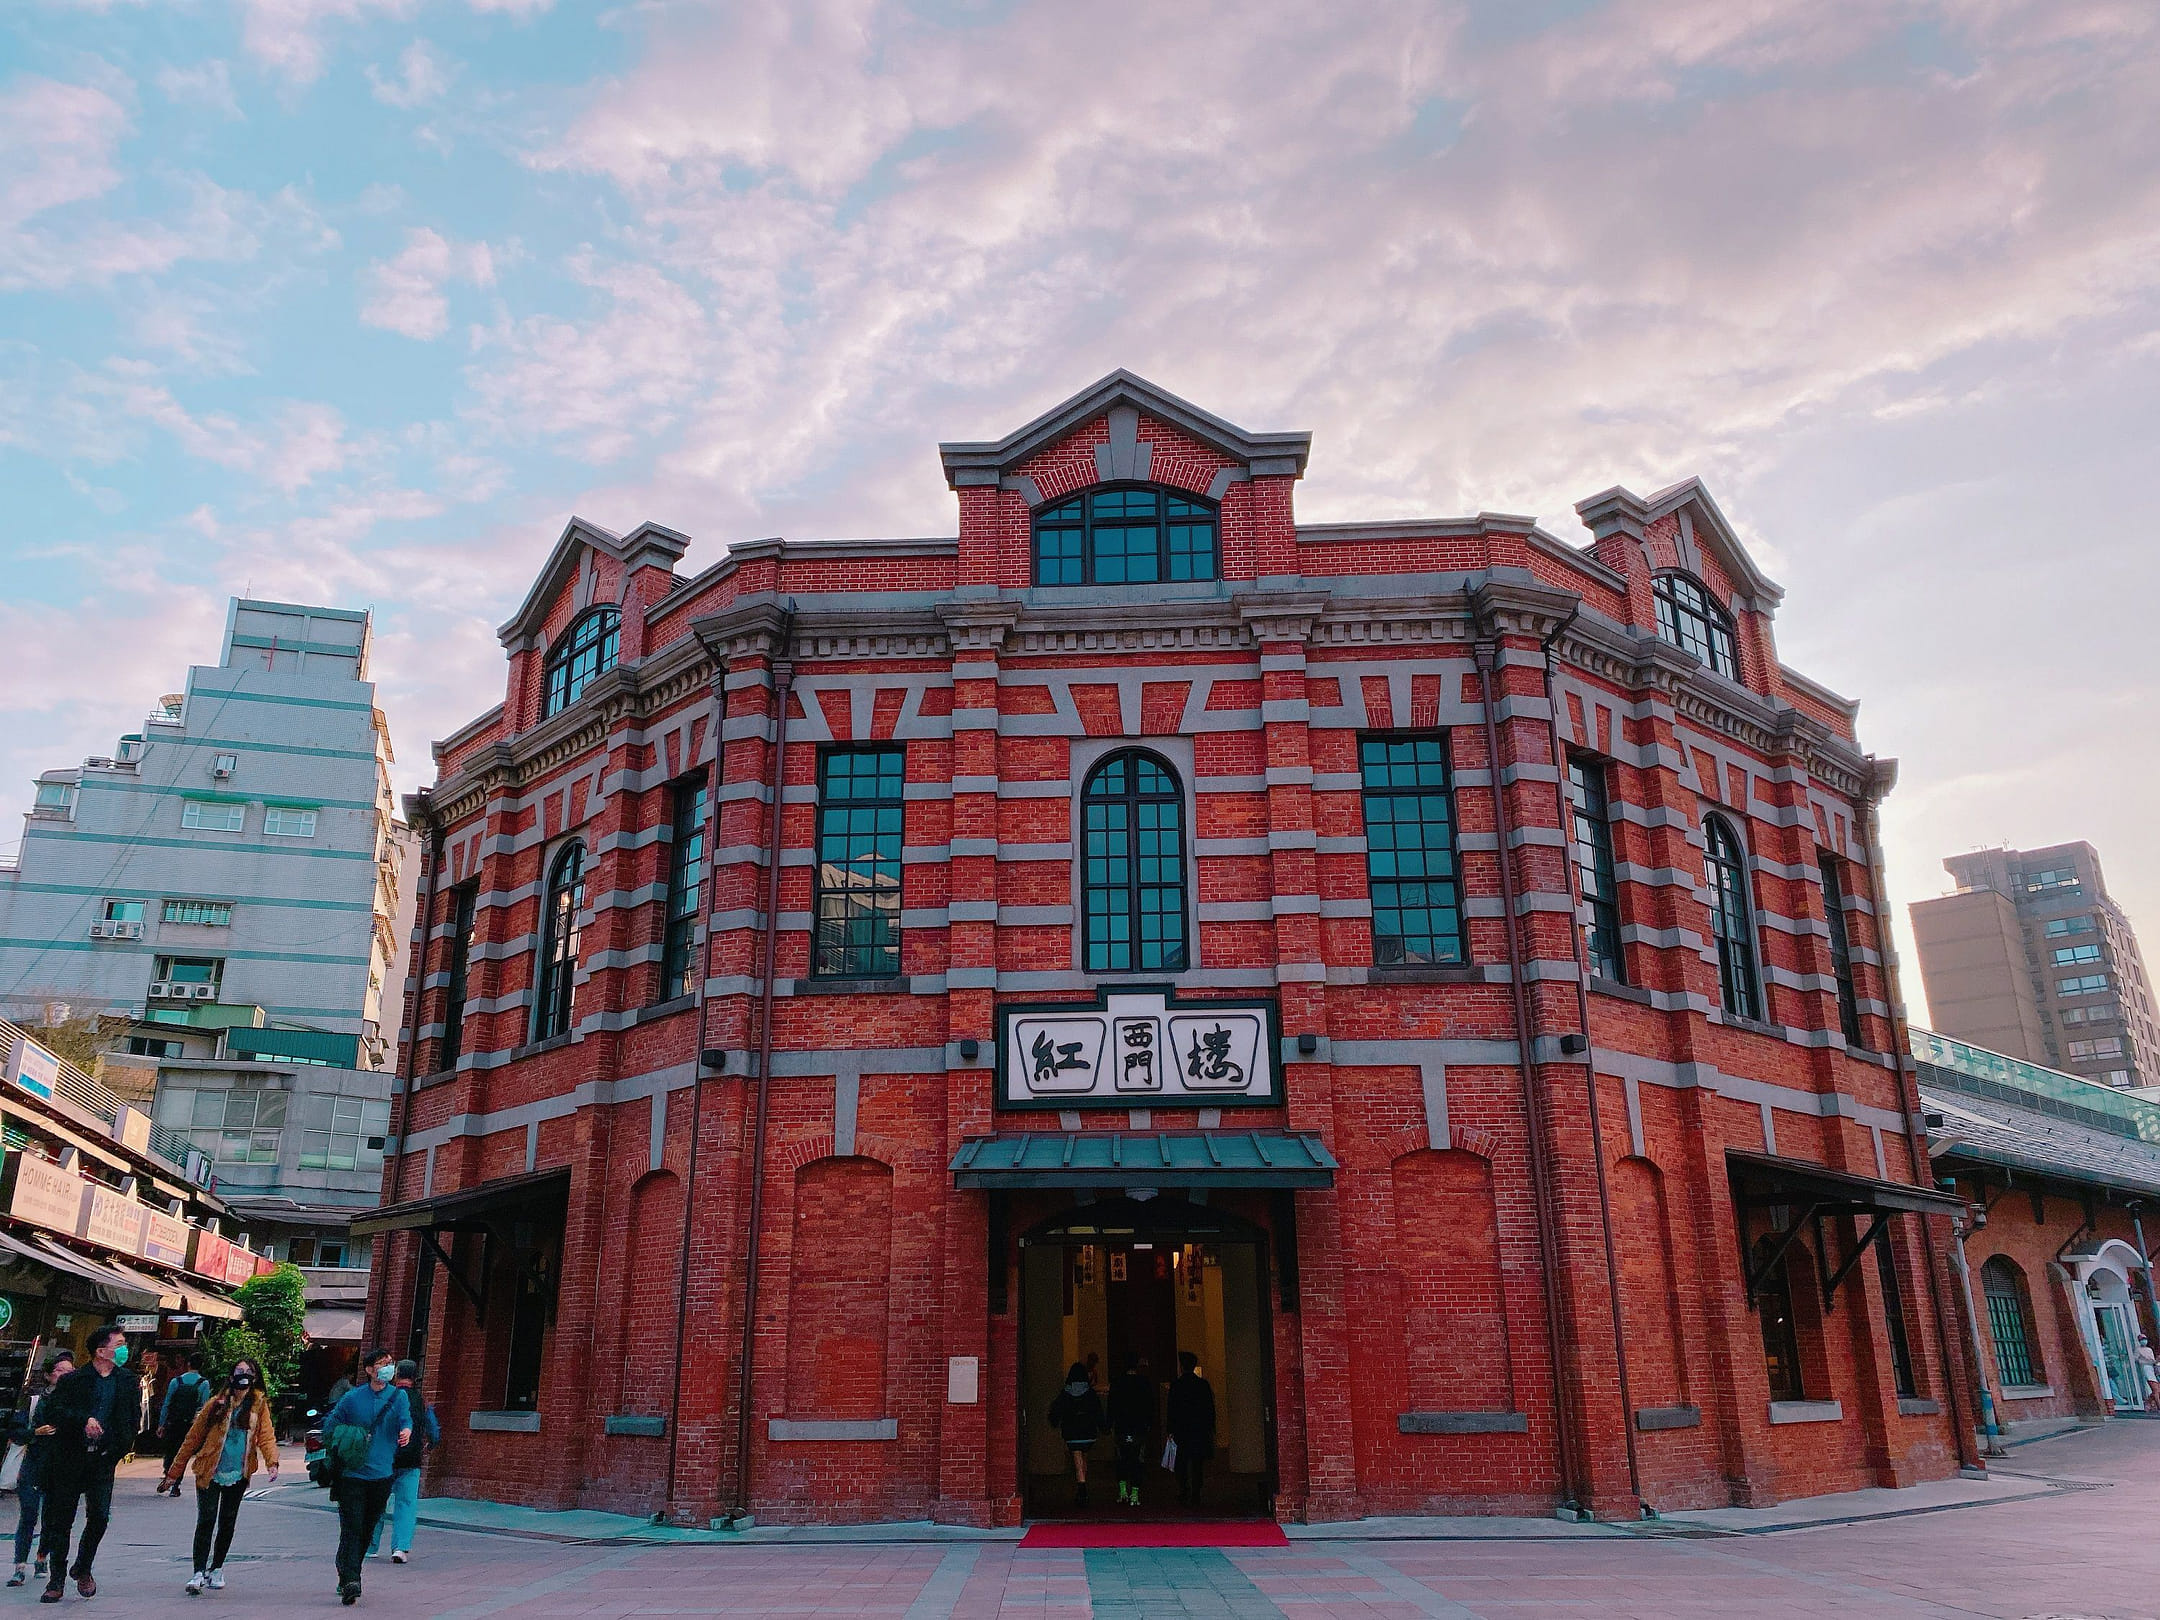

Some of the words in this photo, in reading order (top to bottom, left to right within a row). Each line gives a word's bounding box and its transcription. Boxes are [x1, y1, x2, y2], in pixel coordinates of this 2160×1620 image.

[1032, 1029, 1091, 1082] 紅
[1122, 1022, 1154, 1086] 西門
[22, 1167, 52, 1192] HOMME
[53, 1177, 71, 1200] HAIR
